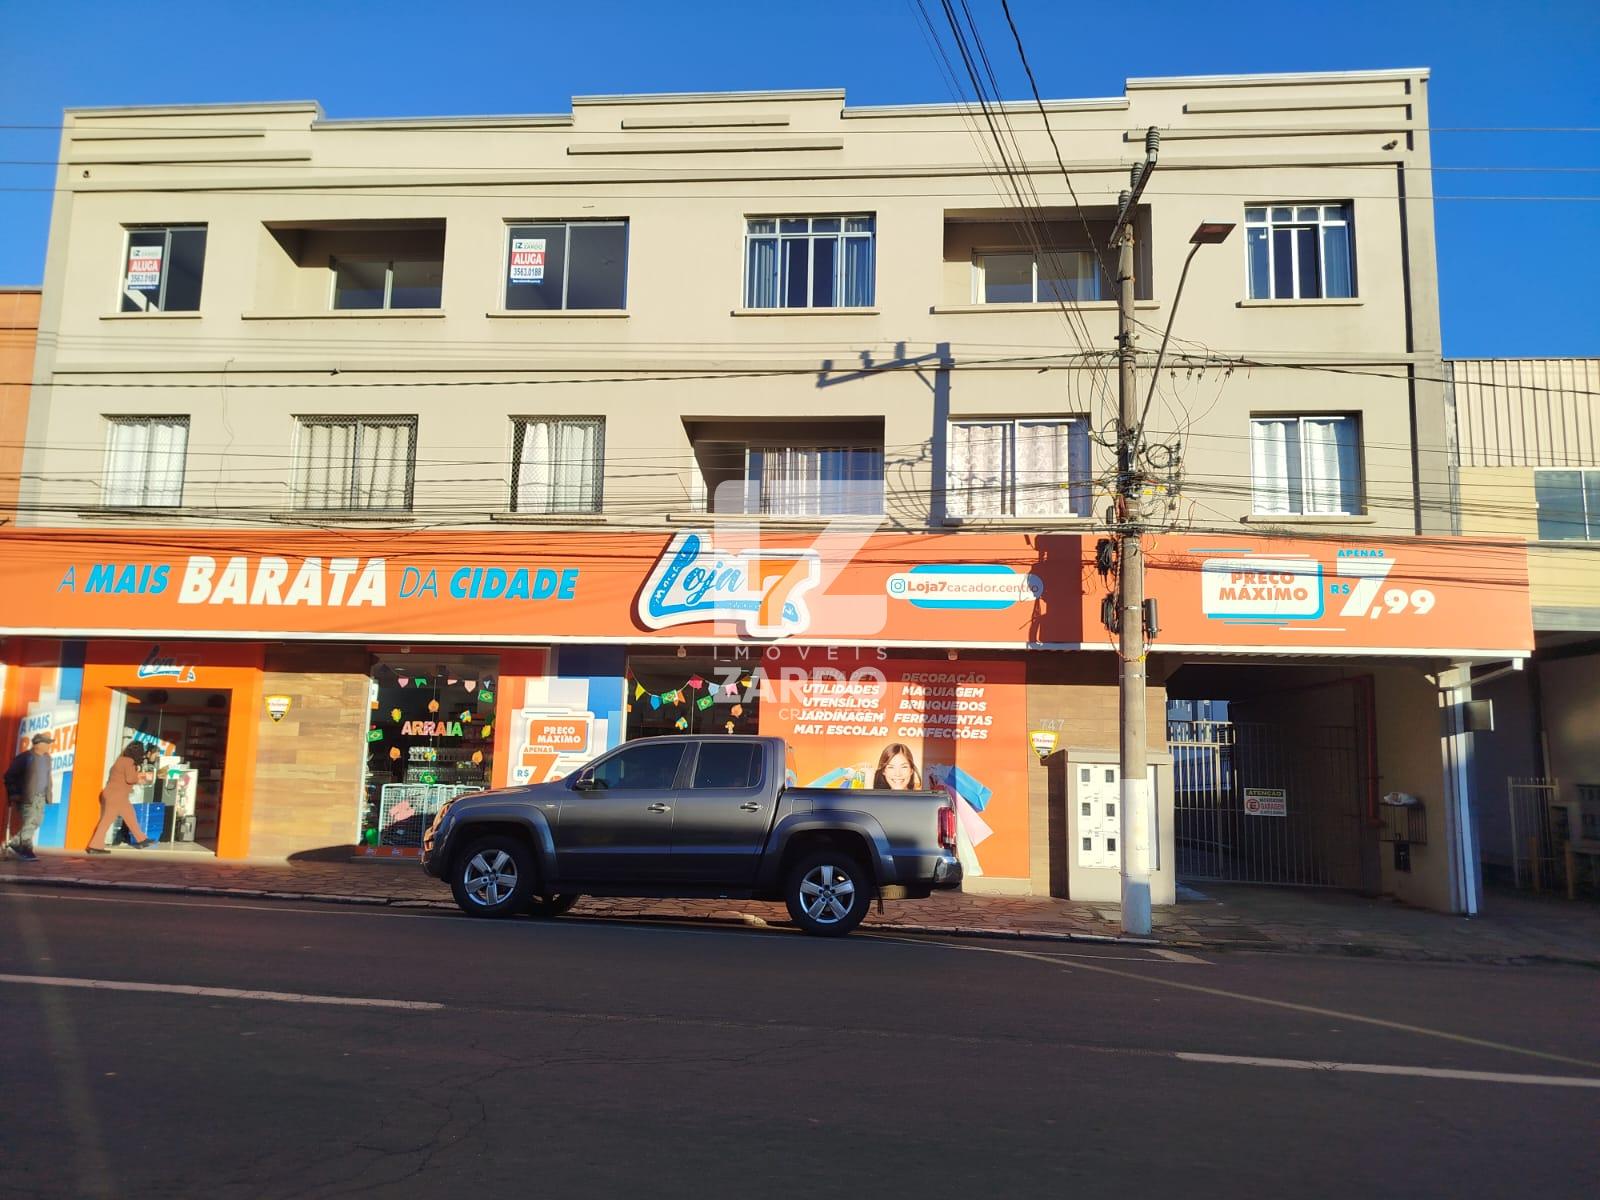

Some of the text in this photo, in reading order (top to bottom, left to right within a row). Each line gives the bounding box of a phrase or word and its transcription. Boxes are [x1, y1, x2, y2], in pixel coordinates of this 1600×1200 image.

[131, 260, 159, 271] ALUGA
[513, 253, 542, 265] ALUGA
[1337, 549, 1385, 558] APENAS
[57, 556, 579, 606] A MAIS BARATA DA CIDADE
[649, 534, 746, 618] Loja
[747, 559, 811, 627] 7
[1230, 571, 1296, 589] PREÇO
[1219, 584, 1309, 601] MÁXIMO
[901, 671, 986, 684] DECORAÇÃO
[802, 683, 880, 695] UTILIDADES
[902, 685, 984, 698] MAQUIAGEM
[802, 696, 880, 709] UTENSÍLIOS
[899, 699, 987, 712] BRINQUEDOS
[798, 710, 884, 723] JARDINAGEM
[893, 712, 993, 726] FERRAMENTAS
[20, 714, 50, 735] A MAIS
[401, 721, 463, 736] ARRAIA
[544, 726, 576, 736] PREÇO
[793, 724, 889, 737] MAT. ESCOLAR
[1039, 719, 1065, 731] 747
[537, 735, 581, 744] MÁXIMO
[898, 726, 988, 740] CONFECÇÕES
[517, 769, 529, 777] R$
